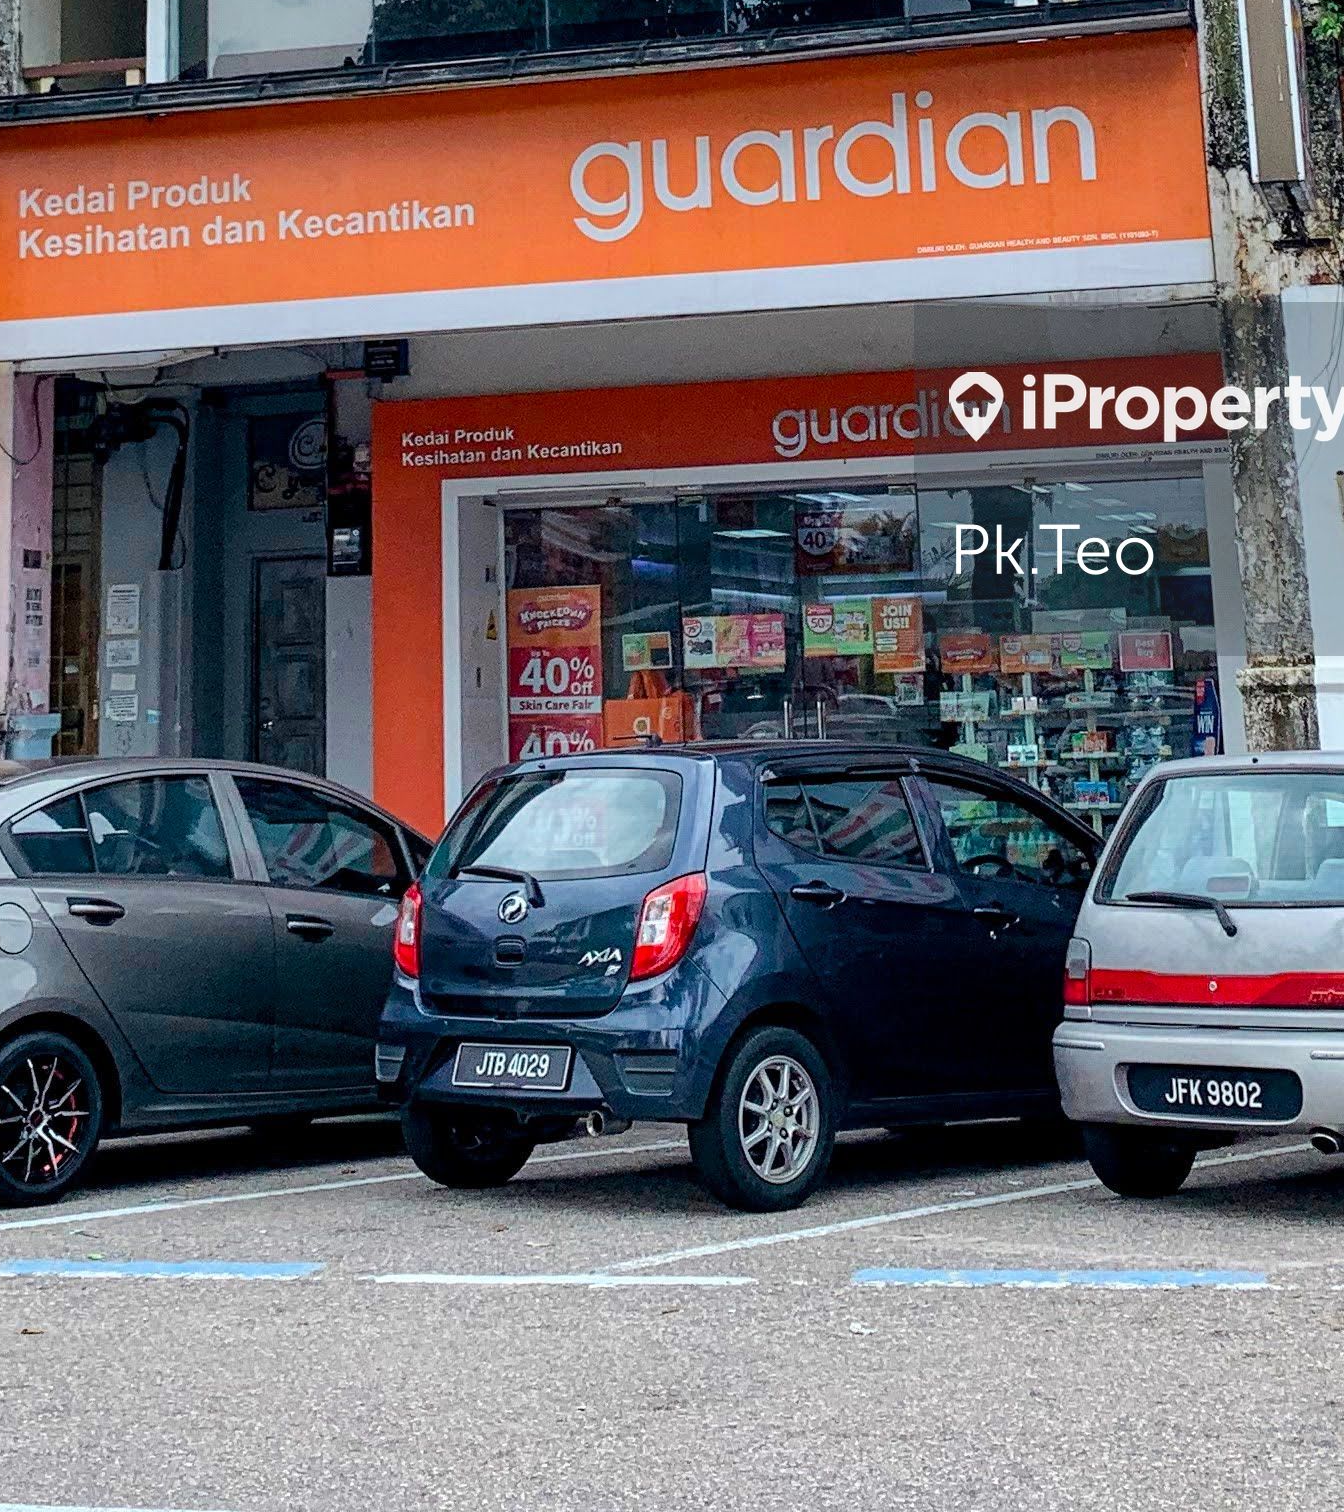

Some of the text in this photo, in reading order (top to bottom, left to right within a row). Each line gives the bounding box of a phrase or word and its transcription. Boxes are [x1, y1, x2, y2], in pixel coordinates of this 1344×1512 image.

[569, 90, 1097, 243] guardian
[18, 173, 252, 218] Kedai Produk
[18, 200, 476, 259] Kesihatan dan Kecantikan
[401, 427, 515, 448] Kedai Produk
[401, 439, 623, 467] Kesihatan dan Kecantikan
[879, 604, 913, 618] JOIN
[571, 681, 594, 695] Off
[519, 699, 594, 711] Skin Care Fair
[577, 947, 623, 966] AXIA
[475, 1051, 550, 1078] JTB 4029
[1164, 1078, 1263, 1109] JFK 9802
